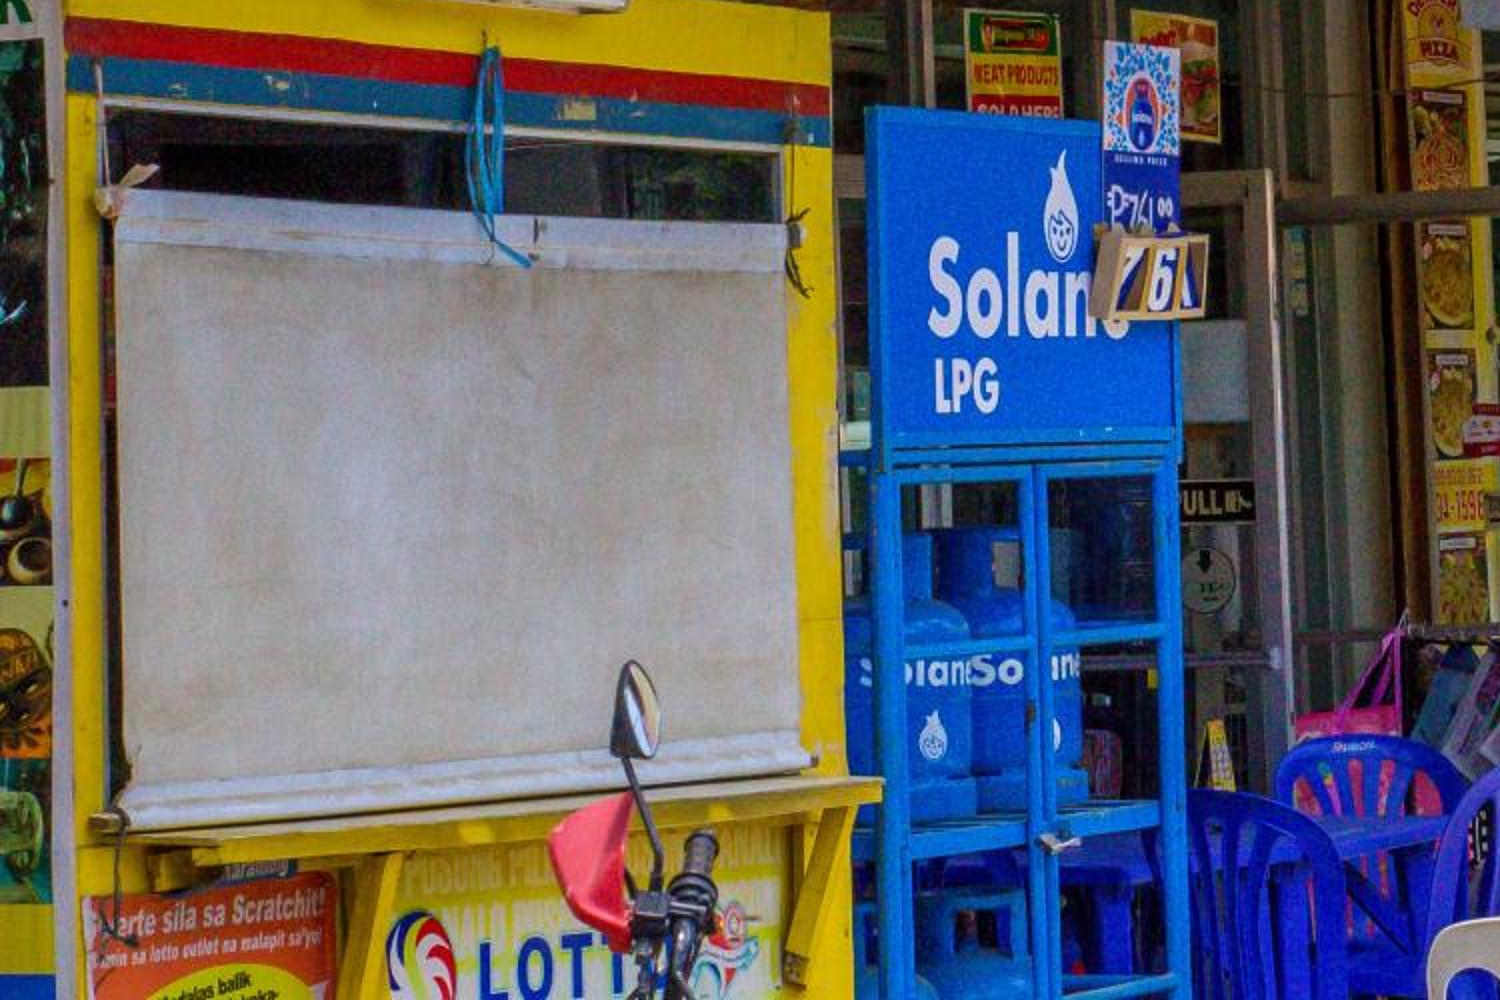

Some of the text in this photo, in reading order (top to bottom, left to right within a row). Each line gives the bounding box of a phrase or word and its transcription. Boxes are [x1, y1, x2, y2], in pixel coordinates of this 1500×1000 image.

[934, 357, 1000, 415] LPG
[1181, 488, 1223, 515] ULL
[162, 904, 197, 934] sila
[203, 904, 226, 928] sa
[230, 886, 326, 926] Scratchit!
[131, 951, 145, 966] sa
[149, 945, 178, 965] lotto
[222, 939, 238, 954] na
[240, 931, 286, 954] malapit
